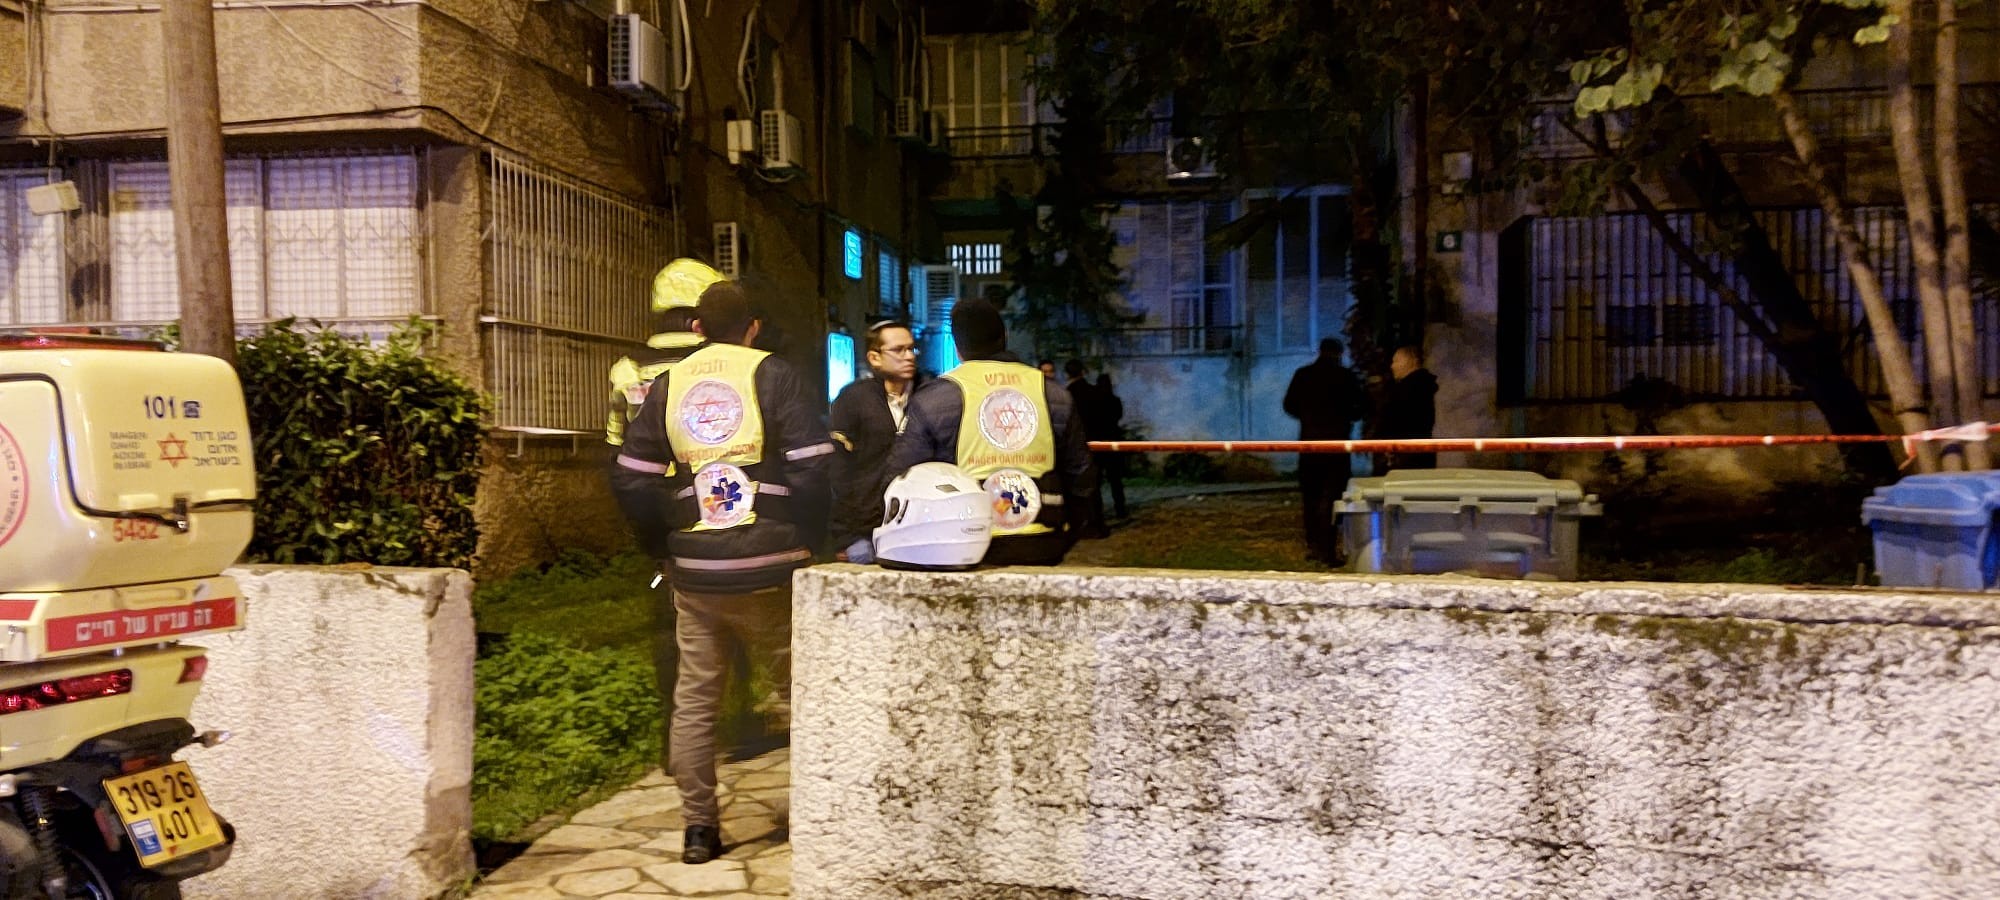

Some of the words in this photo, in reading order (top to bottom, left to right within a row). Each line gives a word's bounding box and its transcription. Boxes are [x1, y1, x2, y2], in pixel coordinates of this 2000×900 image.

[985, 372, 1022, 386] חובש
[144, 396, 176, 418] 101
[192, 431, 213, 441] דוד
[218, 431, 238, 441] מגן
[207, 444, 238, 454] אדום
[113, 518, 159, 542] 5482
[123, 615, 147, 635] של
[153, 611, 188, 633] עניין
[194, 608, 212, 625] זה
[76, 620, 115, 642] חיים
[118, 771, 195, 814] 319-26
[158, 806, 200, 842] 401
